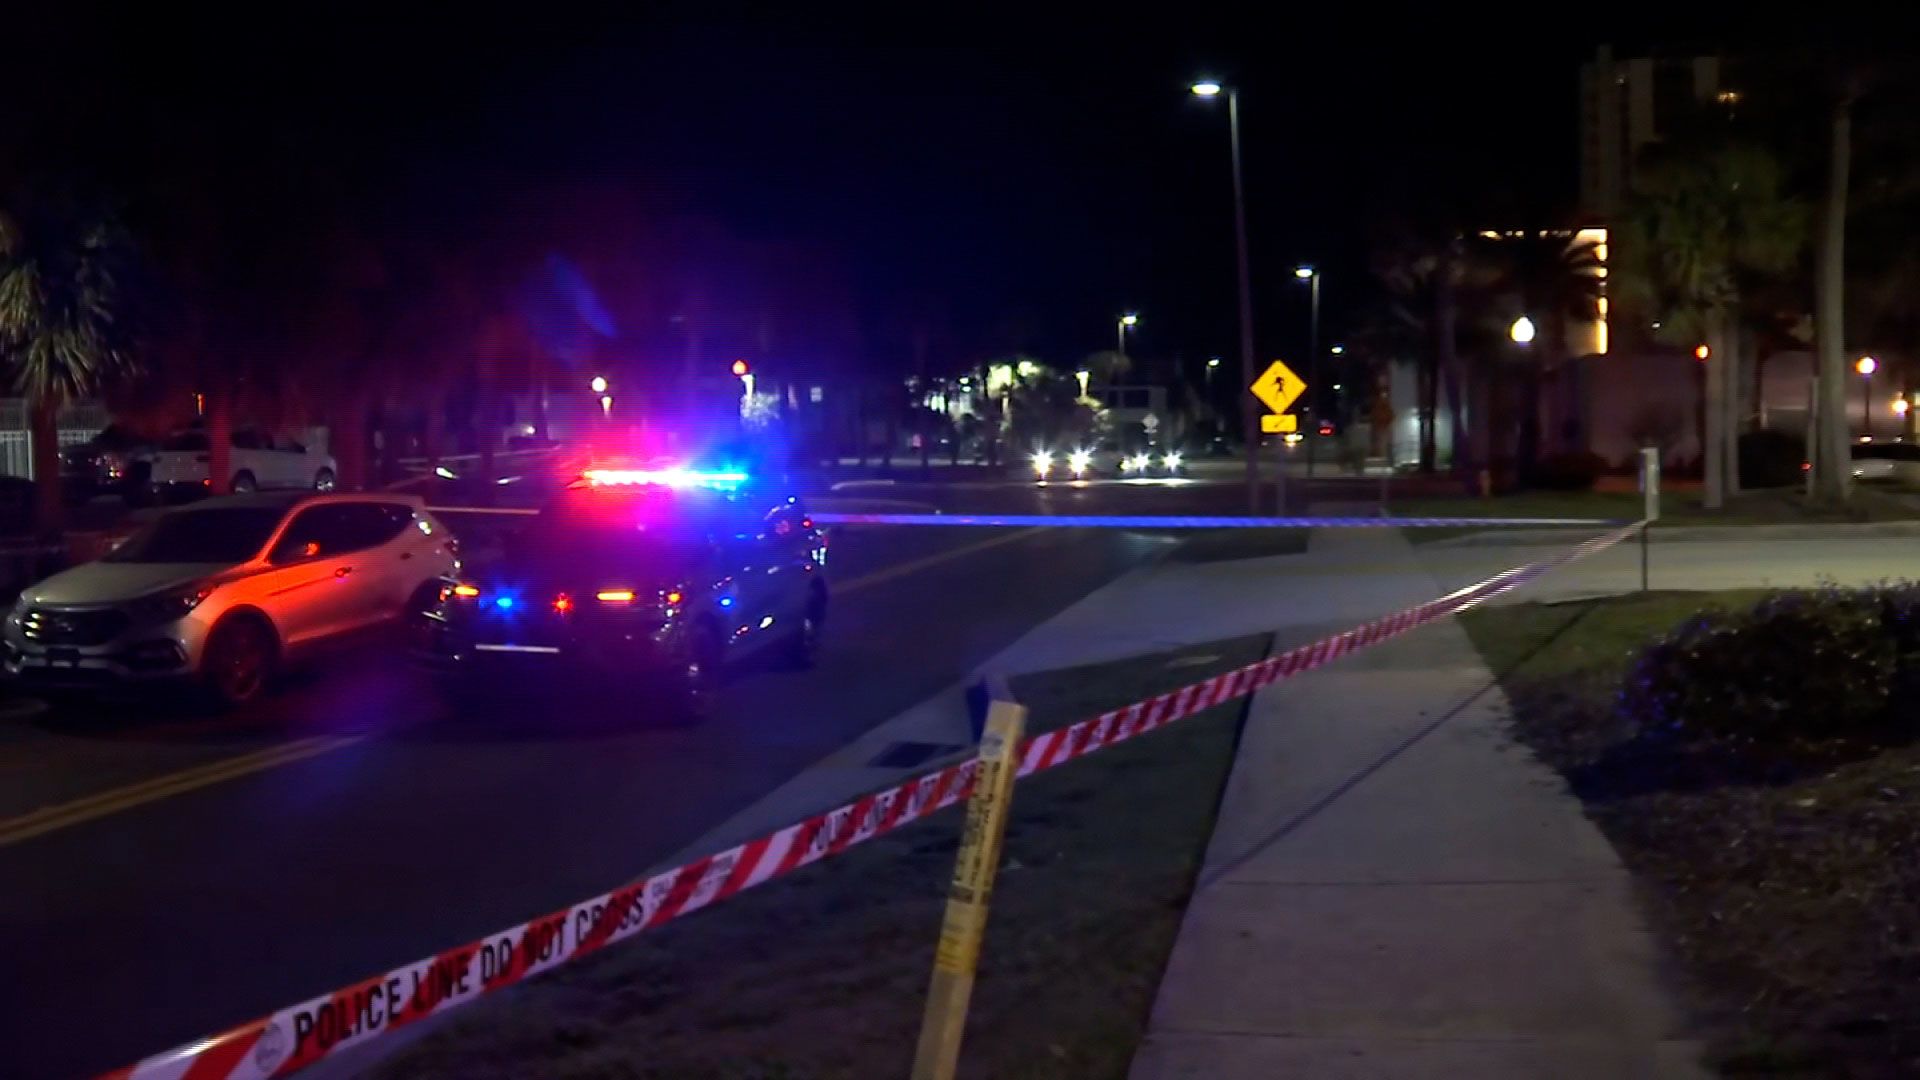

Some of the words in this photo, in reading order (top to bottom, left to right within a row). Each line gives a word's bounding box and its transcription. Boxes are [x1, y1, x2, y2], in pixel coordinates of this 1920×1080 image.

[293, 977, 402, 1057] POLICE
[411, 953, 470, 1012] LINE
[480, 938, 513, 984] DO
[522, 917, 566, 966] NOT
[576, 889, 645, 947] CROSS
